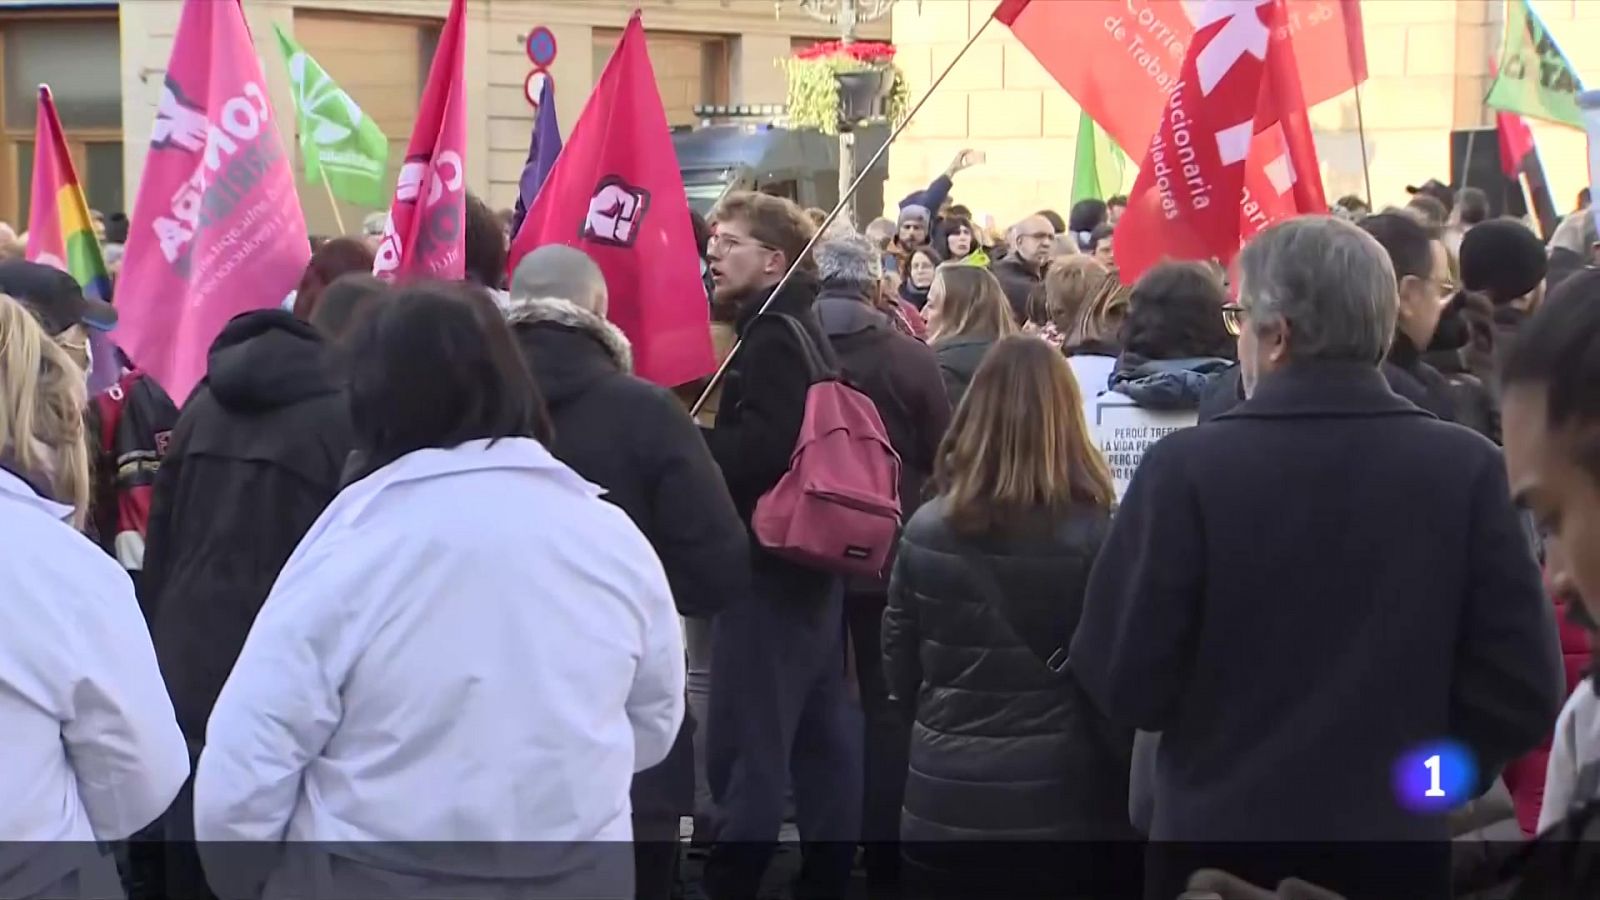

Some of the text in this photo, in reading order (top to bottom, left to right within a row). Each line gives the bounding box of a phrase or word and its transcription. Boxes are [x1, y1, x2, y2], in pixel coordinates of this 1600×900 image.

[1104, 16, 1126, 41] de
[1151, 427, 1178, 438] TRE
[1114, 440, 1134, 452] VIDA
